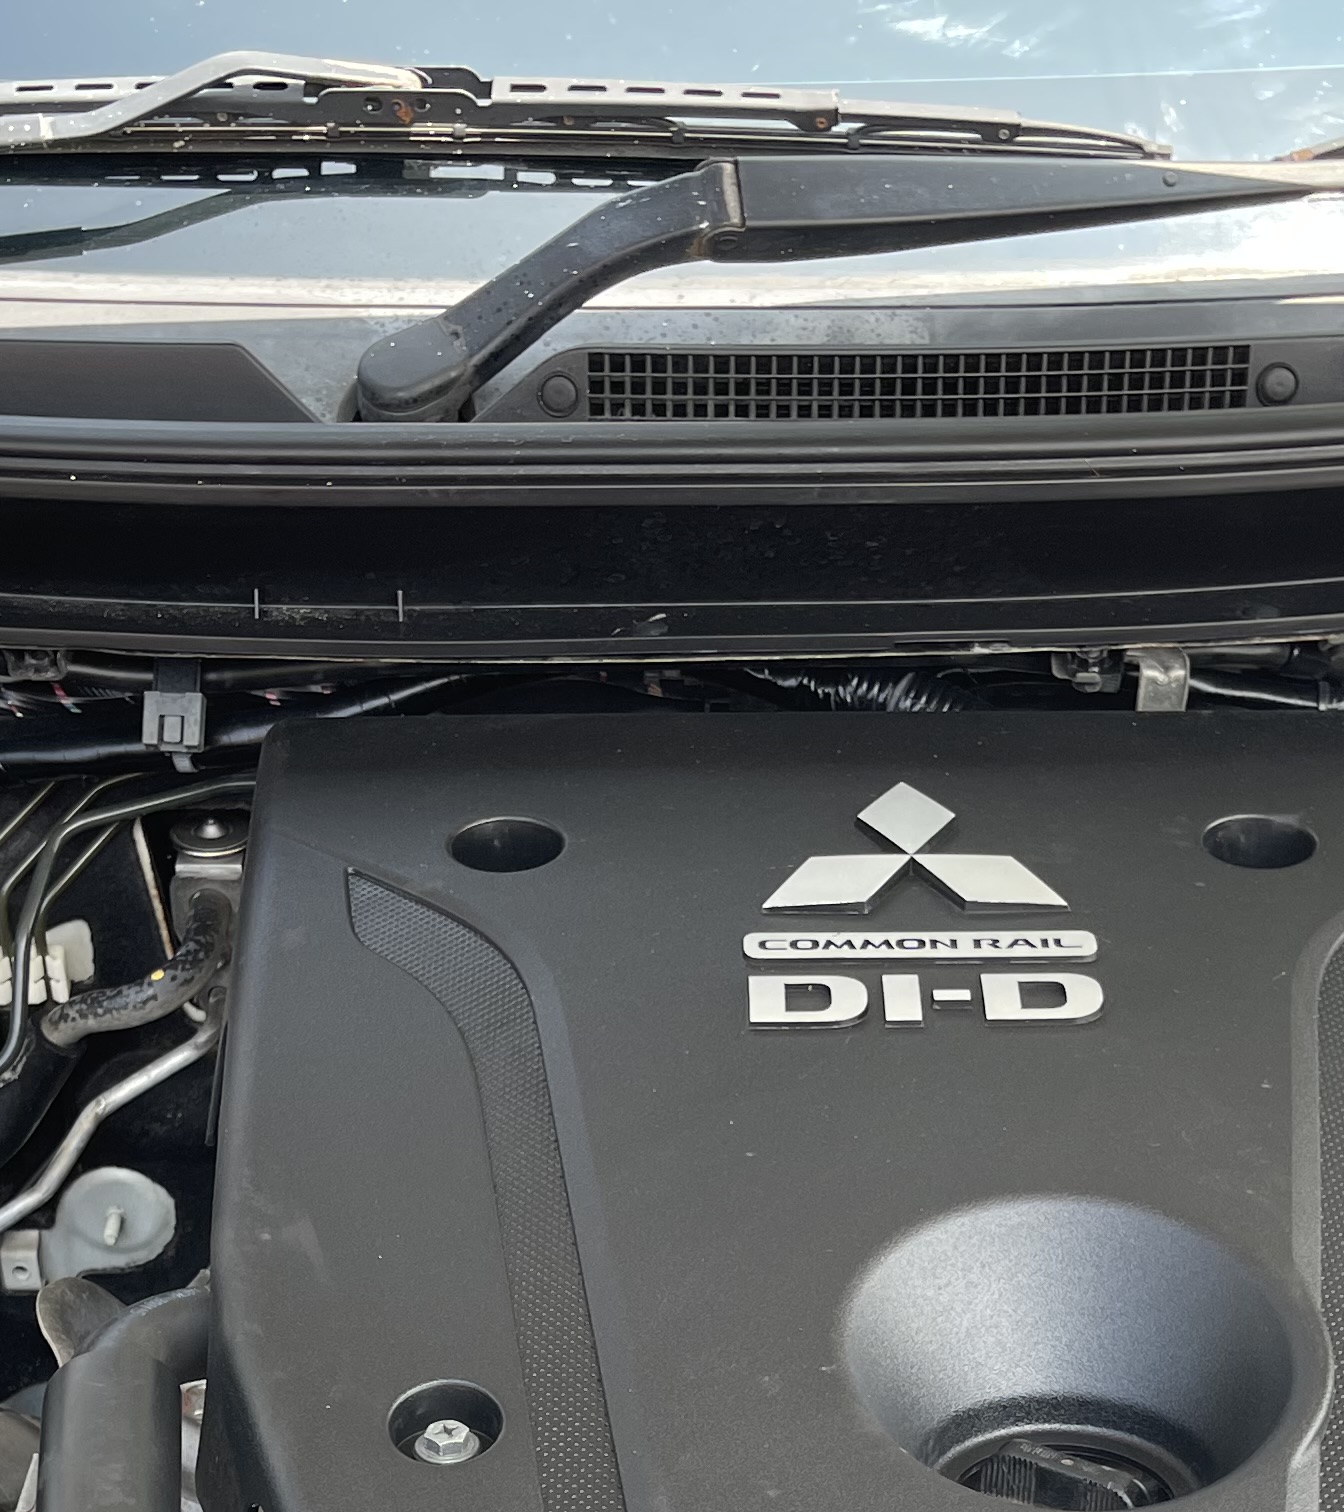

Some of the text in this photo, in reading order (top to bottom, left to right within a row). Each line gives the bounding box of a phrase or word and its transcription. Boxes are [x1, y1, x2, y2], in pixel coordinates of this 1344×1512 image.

[758, 938, 1083, 951] COMMON RAIL
[748, 972, 1104, 1024] DI-D
